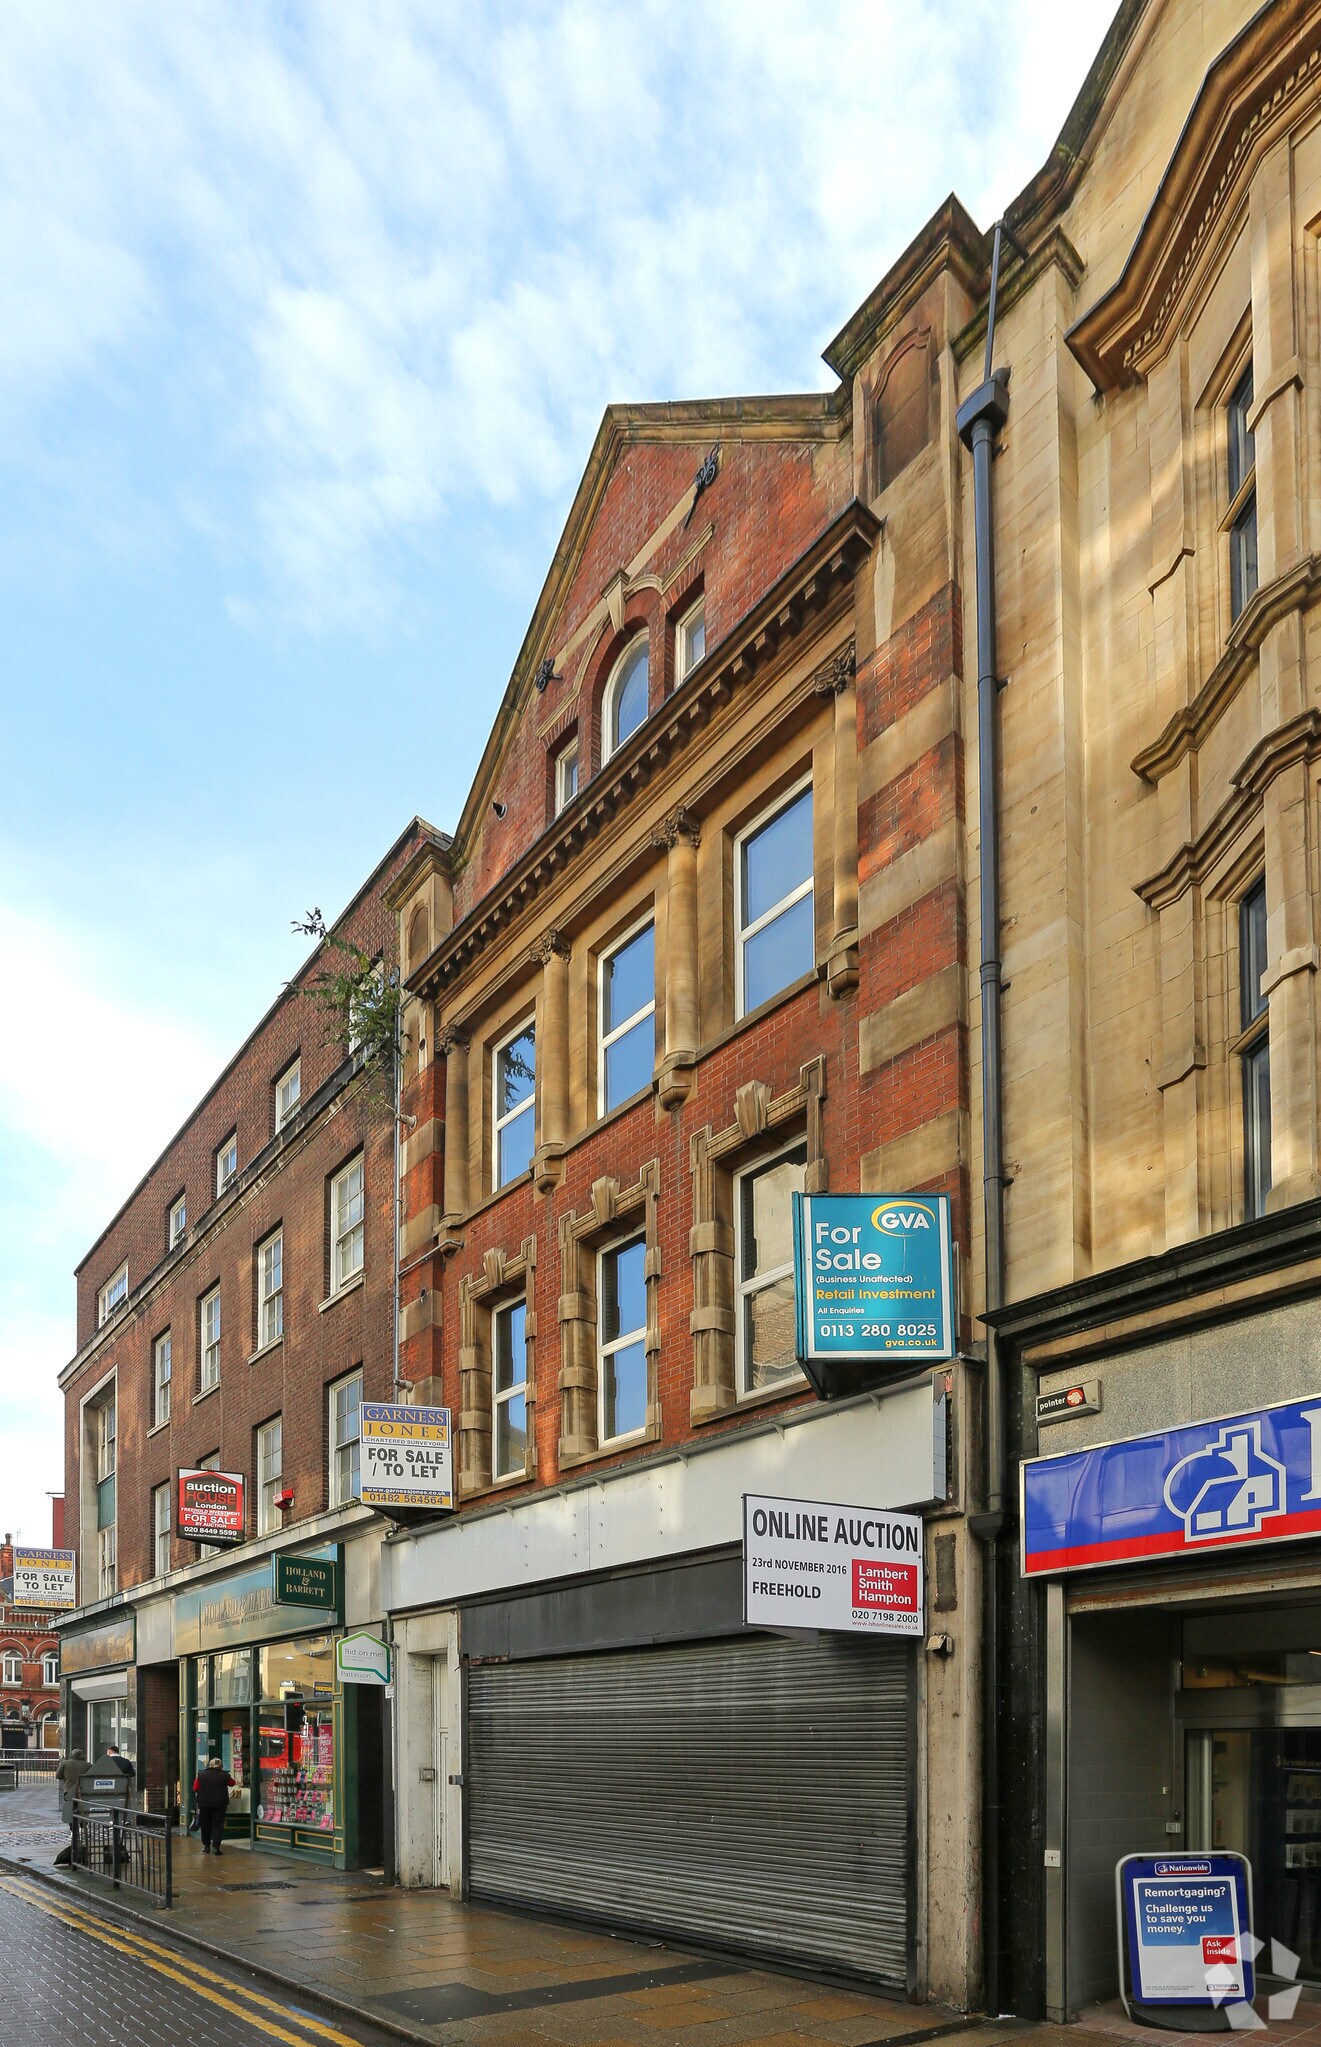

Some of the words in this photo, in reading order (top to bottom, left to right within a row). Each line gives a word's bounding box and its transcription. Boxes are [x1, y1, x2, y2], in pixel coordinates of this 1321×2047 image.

[881, 1212, 930, 1229] GVA
[816, 1222, 862, 1244] For
[816, 1248, 882, 1270] Sale
[816, 1275, 857, 1284] (Business
[860, 1275, 913, 1284] Unaffected)
[816, 1289, 854, 1300] Retail
[859, 1289, 936, 1299] Investment
[830, 1307, 865, 1315] Enquiries
[820, 1324, 854, 1337] 0113
[861, 1324, 890, 1336] 280
[897, 1324, 936, 1336] 8025
[885, 1338, 937, 1348] gva.co.uk
[1039, 1397, 1066, 1411] pointer
[366, 1408, 444, 1424] GARNESS
[368, 1423, 444, 1439] JONES
[368, 1448, 398, 1461] FOR
[406, 1450, 443, 1464] SALE
[372, 1462, 377, 1476] /
[384, 1463, 404, 1476] TO
[412, 1465, 439, 1478] LET
[186, 1482, 236, 1494] auction
[366, 1487, 446, 1496] www.garnessjones.co.uk
[186, 1492, 236, 1504] HOUSE
[369, 1493, 399, 1502] 01482
[404, 1495, 443, 1504] 564564
[196, 1502, 227, 1510] London
[184, 1514, 206, 1522] FOR
[210, 1516, 237, 1525] SALE
[752, 1508, 829, 1542] ONLINE
[834, 1518, 918, 1552] AUCTION
[18, 1550, 71, 1560] GARNESS
[18, 1559, 71, 1568] JONES
[752, 1558, 772, 1568] 23rd
[775, 1559, 825, 1573] NOVEMBER
[826, 1564, 847, 1575] 2016
[43, 1574, 73, 1583] SALE/
[286, 1567, 325, 1580] HOLLAND
[858, 1565, 908, 1580] Lambert
[302, 1577, 310, 1586] &
[858, 1578, 893, 1591] Smith
[286, 1584, 325, 1597] BARRETT
[752, 1581, 821, 1599] FREEHOLD
[858, 1590, 912, 1605] Hampton
[852, 1610, 869, 1619] 020
[872, 1612, 894, 1621] 7198
[897, 1614, 918, 1623] 2000
[1144, 1887, 1225, 1898] Remortgaging?
[1146, 1904, 1198, 1914] Challenge
[1201, 1904, 1213, 1912] us
[1146, 1914, 1157, 1922] to
[1186, 1915, 1206, 1924] you
[1147, 1926, 1185, 1934] money.
